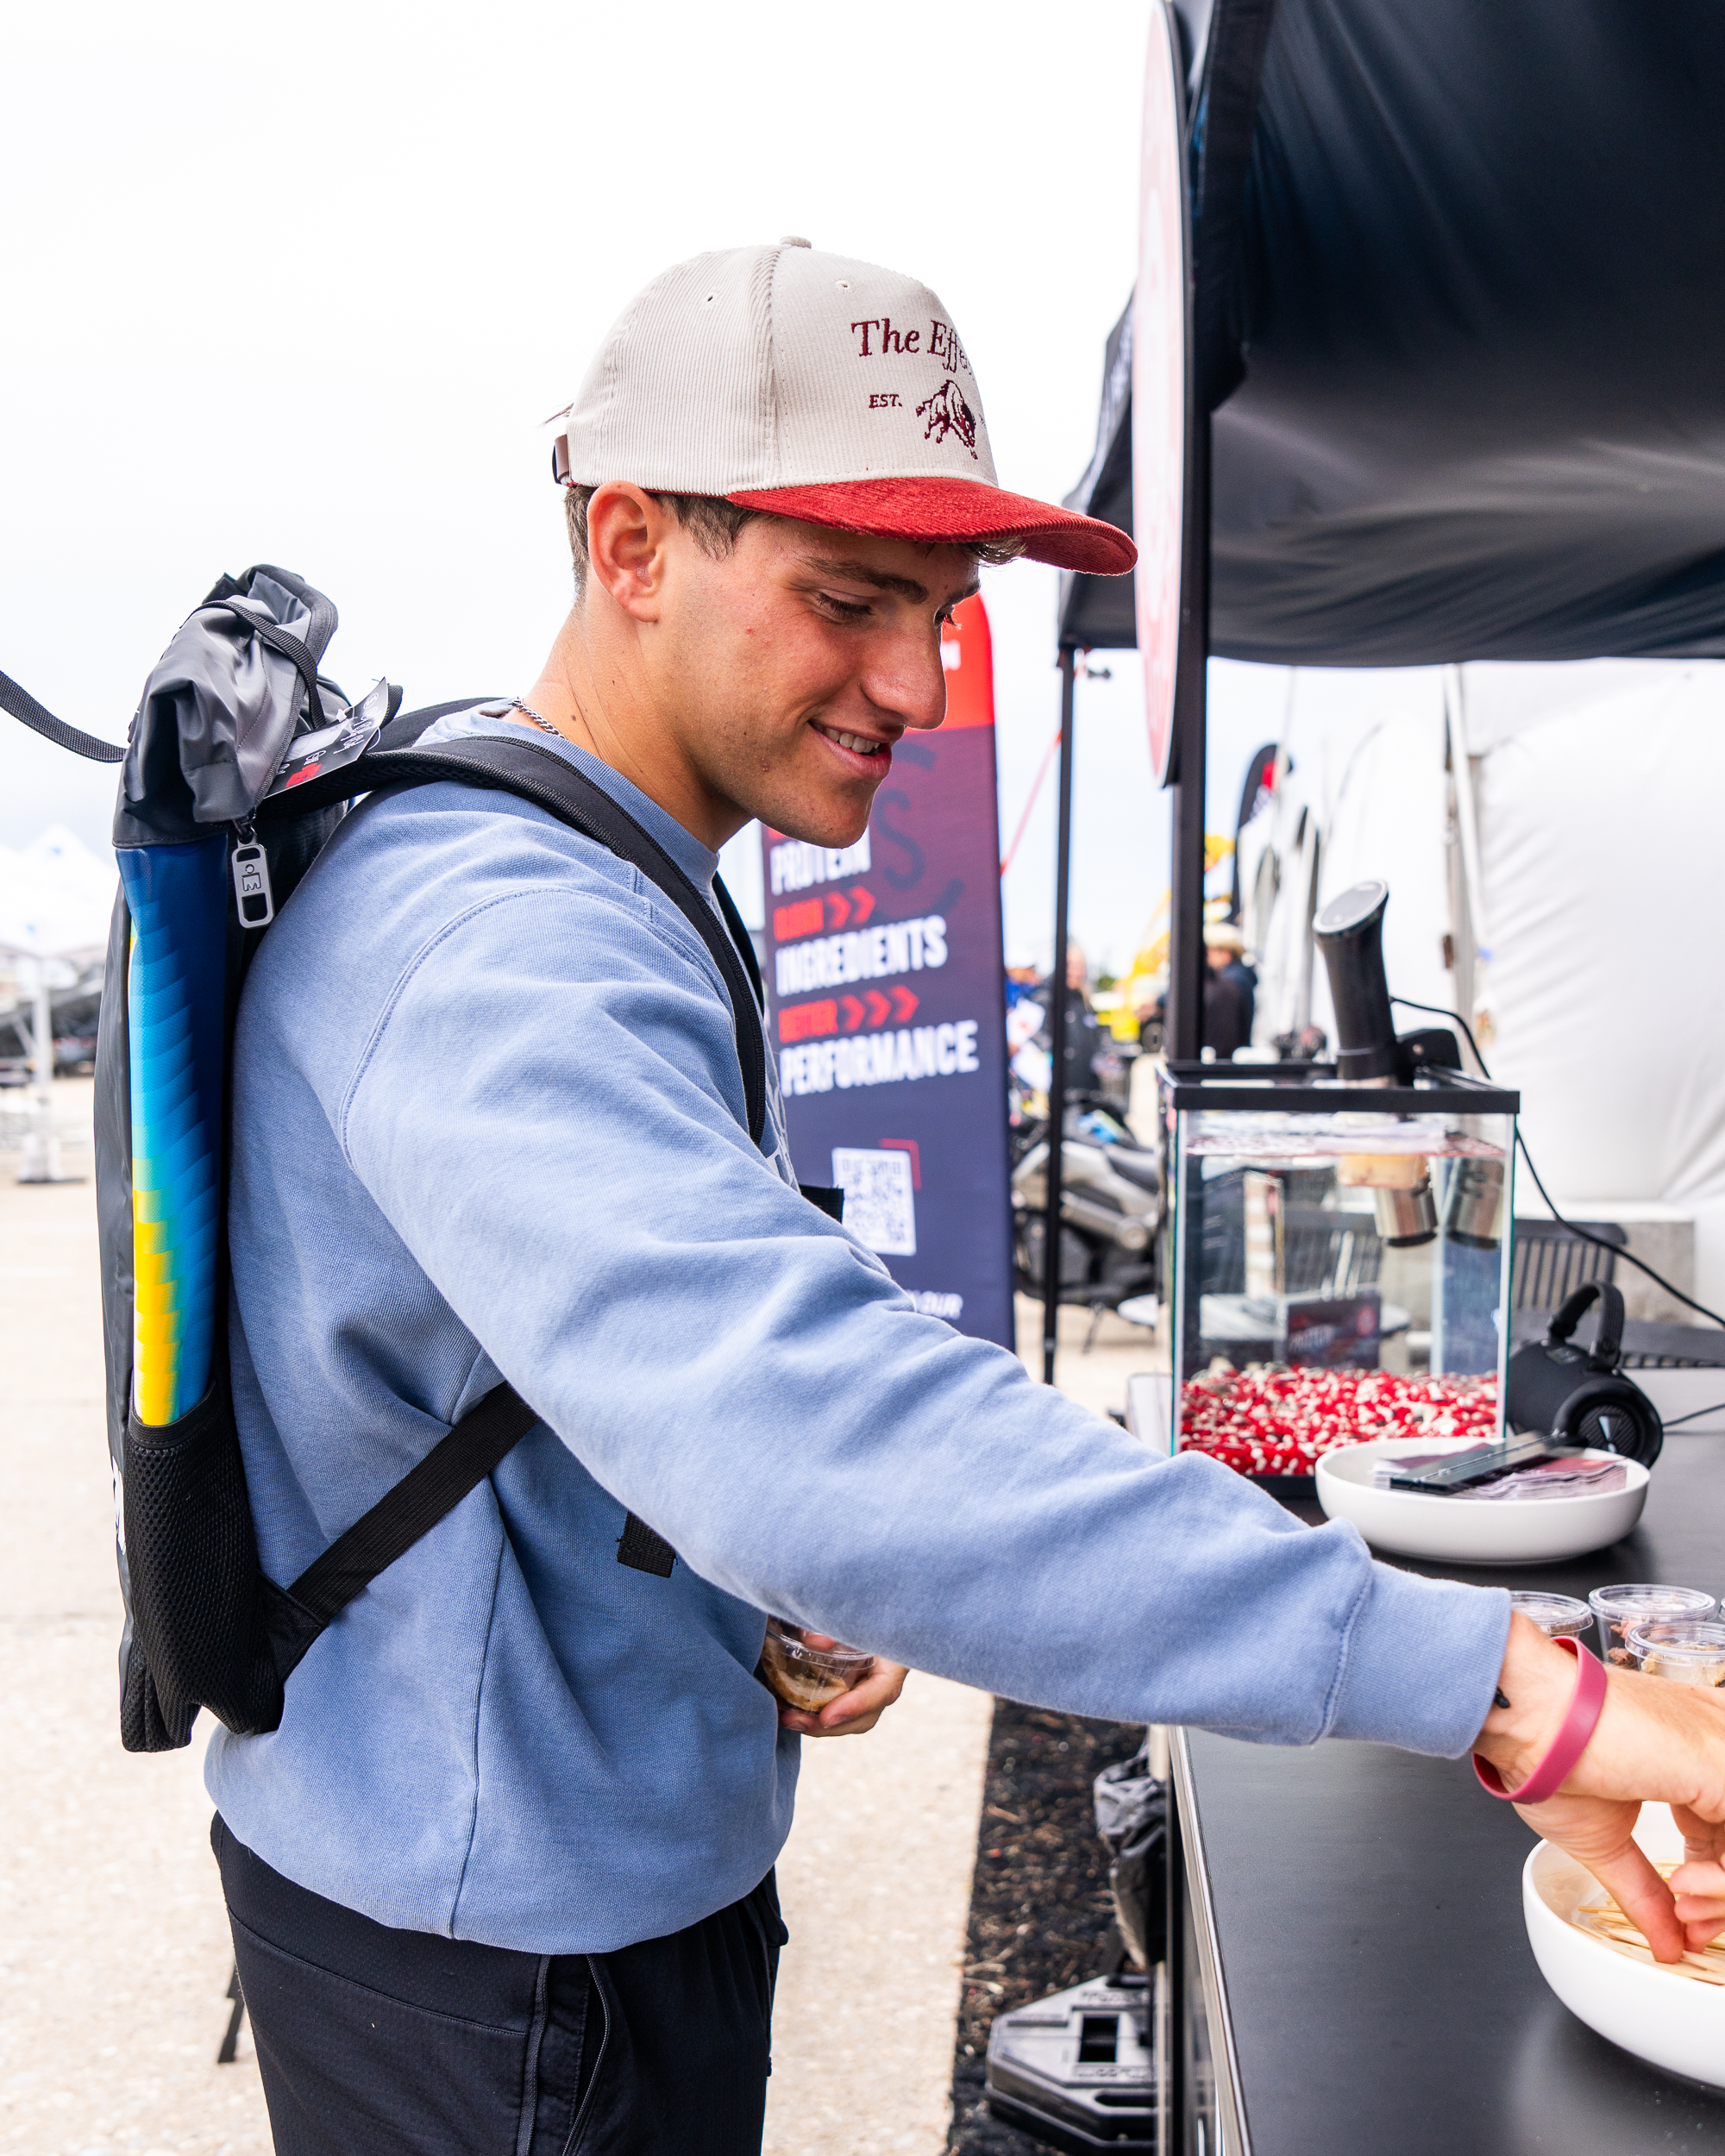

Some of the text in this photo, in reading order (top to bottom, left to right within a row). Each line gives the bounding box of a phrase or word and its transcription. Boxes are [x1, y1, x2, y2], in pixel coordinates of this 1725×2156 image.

[850, 318, 971, 375] The Effe
[869, 393, 903, 409] EST.
[775, 914, 948, 997] INGREDIENTS
[779, 1018, 980, 1098] PERFORMANCE
